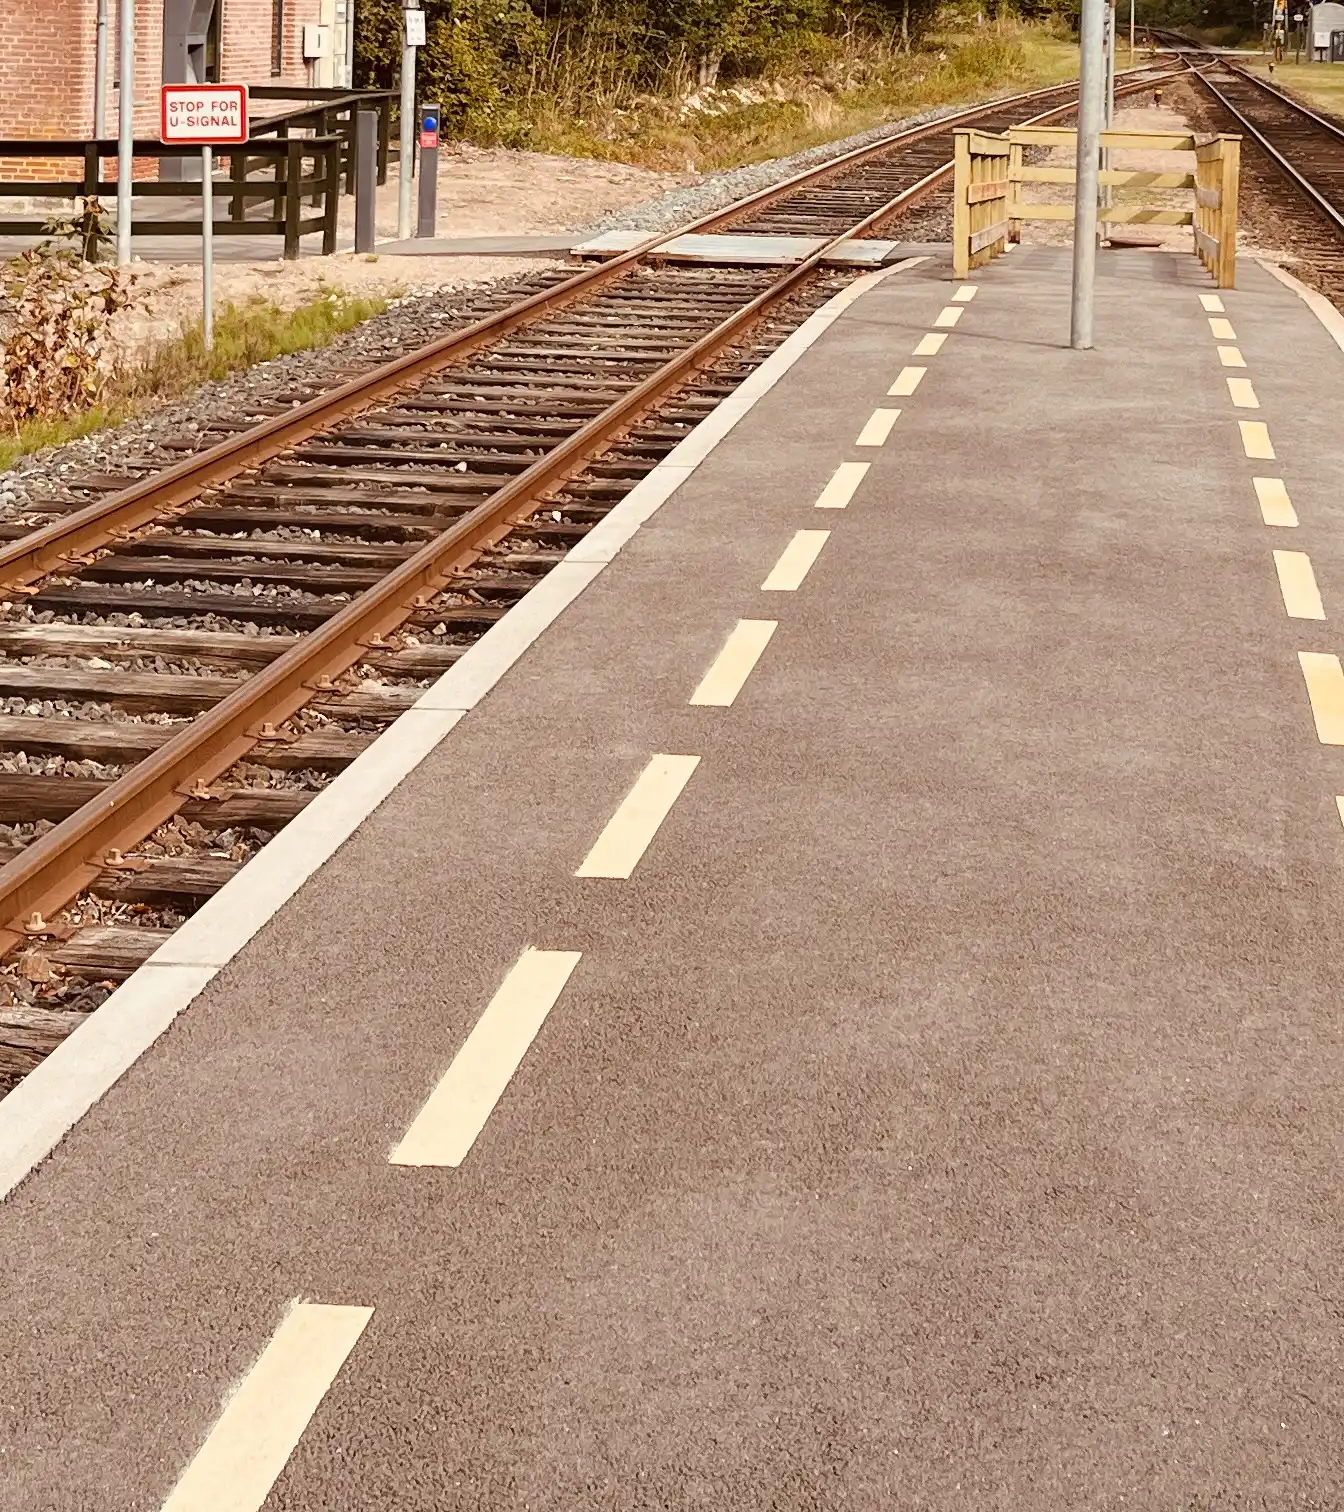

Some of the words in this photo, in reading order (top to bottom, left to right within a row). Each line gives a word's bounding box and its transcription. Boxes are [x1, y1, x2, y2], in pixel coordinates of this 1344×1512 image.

[169, 101, 204, 112] STOP
[211, 100, 238, 112] FOR
[169, 116, 238, 127] U-SIGNAL
